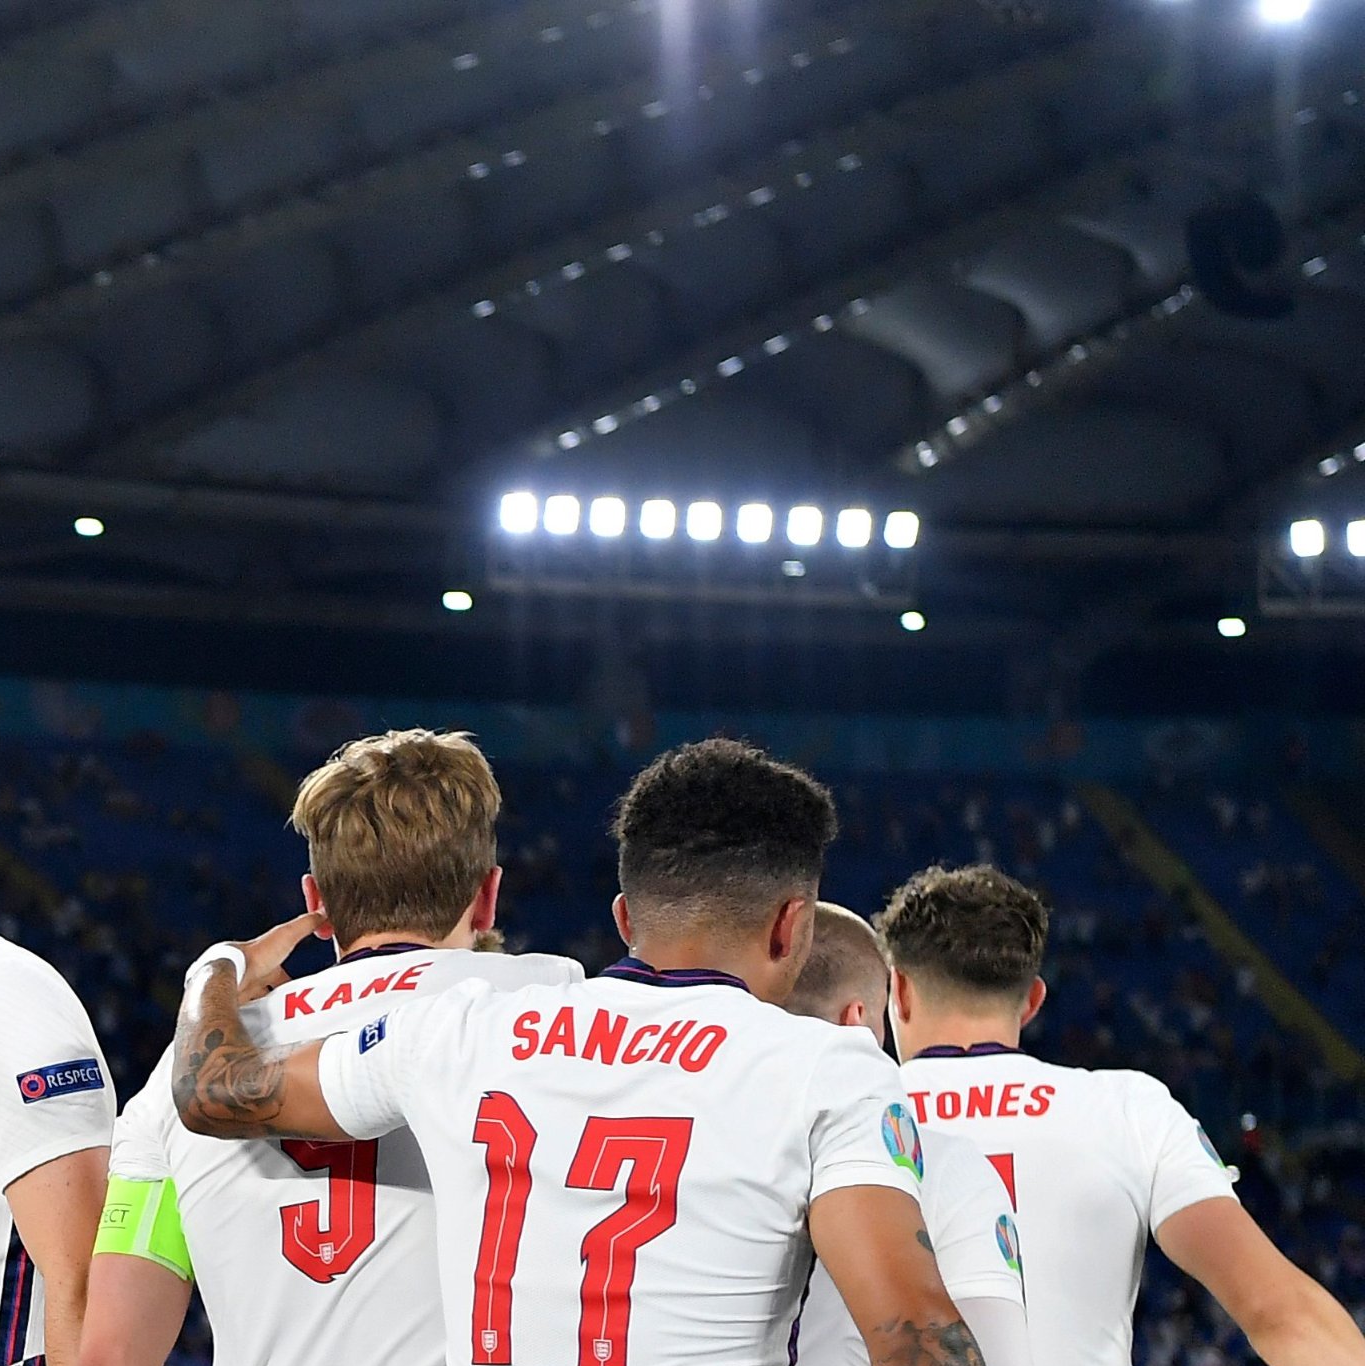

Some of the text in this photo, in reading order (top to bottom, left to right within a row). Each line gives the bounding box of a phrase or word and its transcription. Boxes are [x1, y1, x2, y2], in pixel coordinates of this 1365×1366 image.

[284, 961, 434, 1020] KANE
[512, 1007, 727, 1073] SANCHO
[46, 1067, 101, 1088] RESPECT
